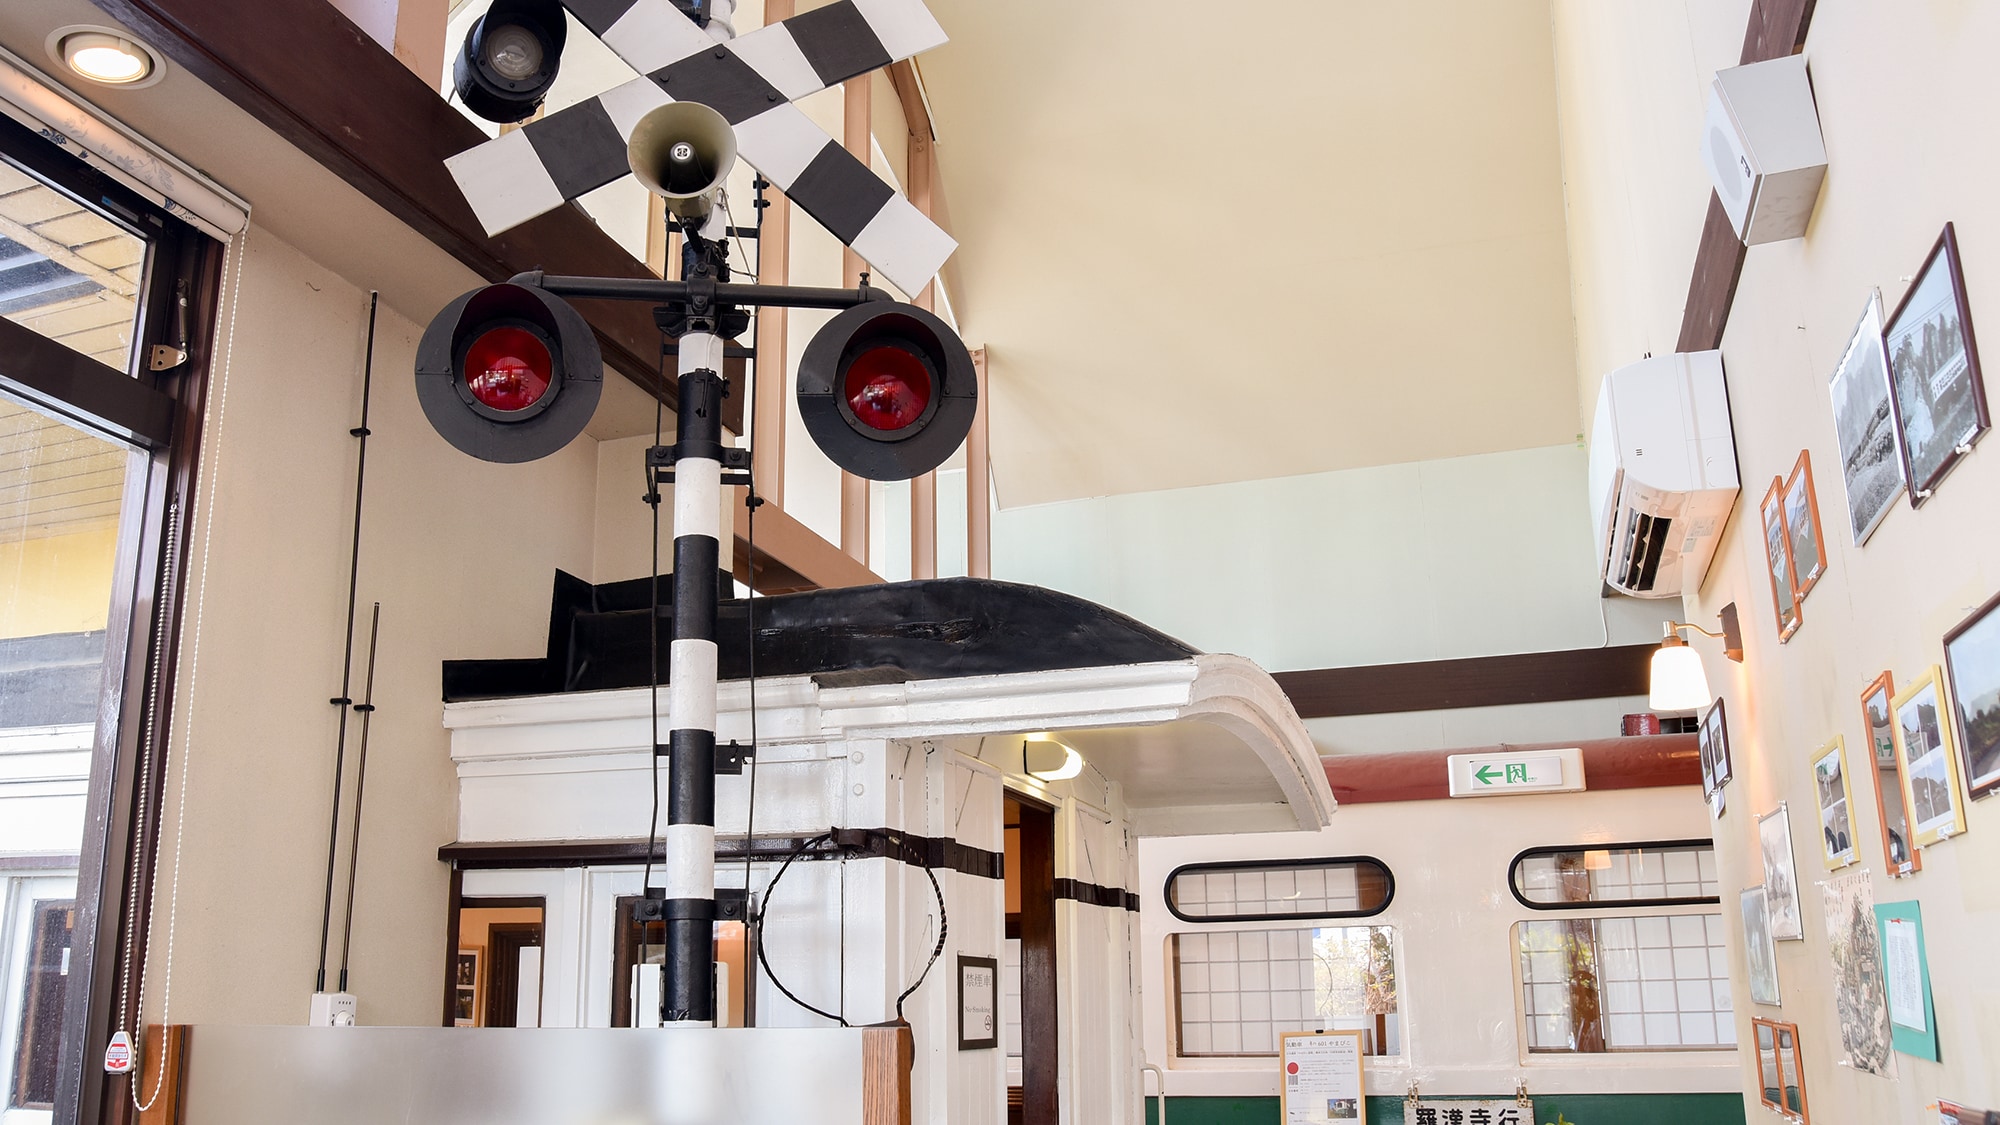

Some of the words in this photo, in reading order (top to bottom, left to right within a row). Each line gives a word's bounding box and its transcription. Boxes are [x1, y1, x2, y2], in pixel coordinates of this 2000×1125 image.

[966, 973, 992, 987] 禁煙車
[972, 1006, 991, 1014] Smoking
[1416, 1108, 1520, 1125] 羅漢寺行
